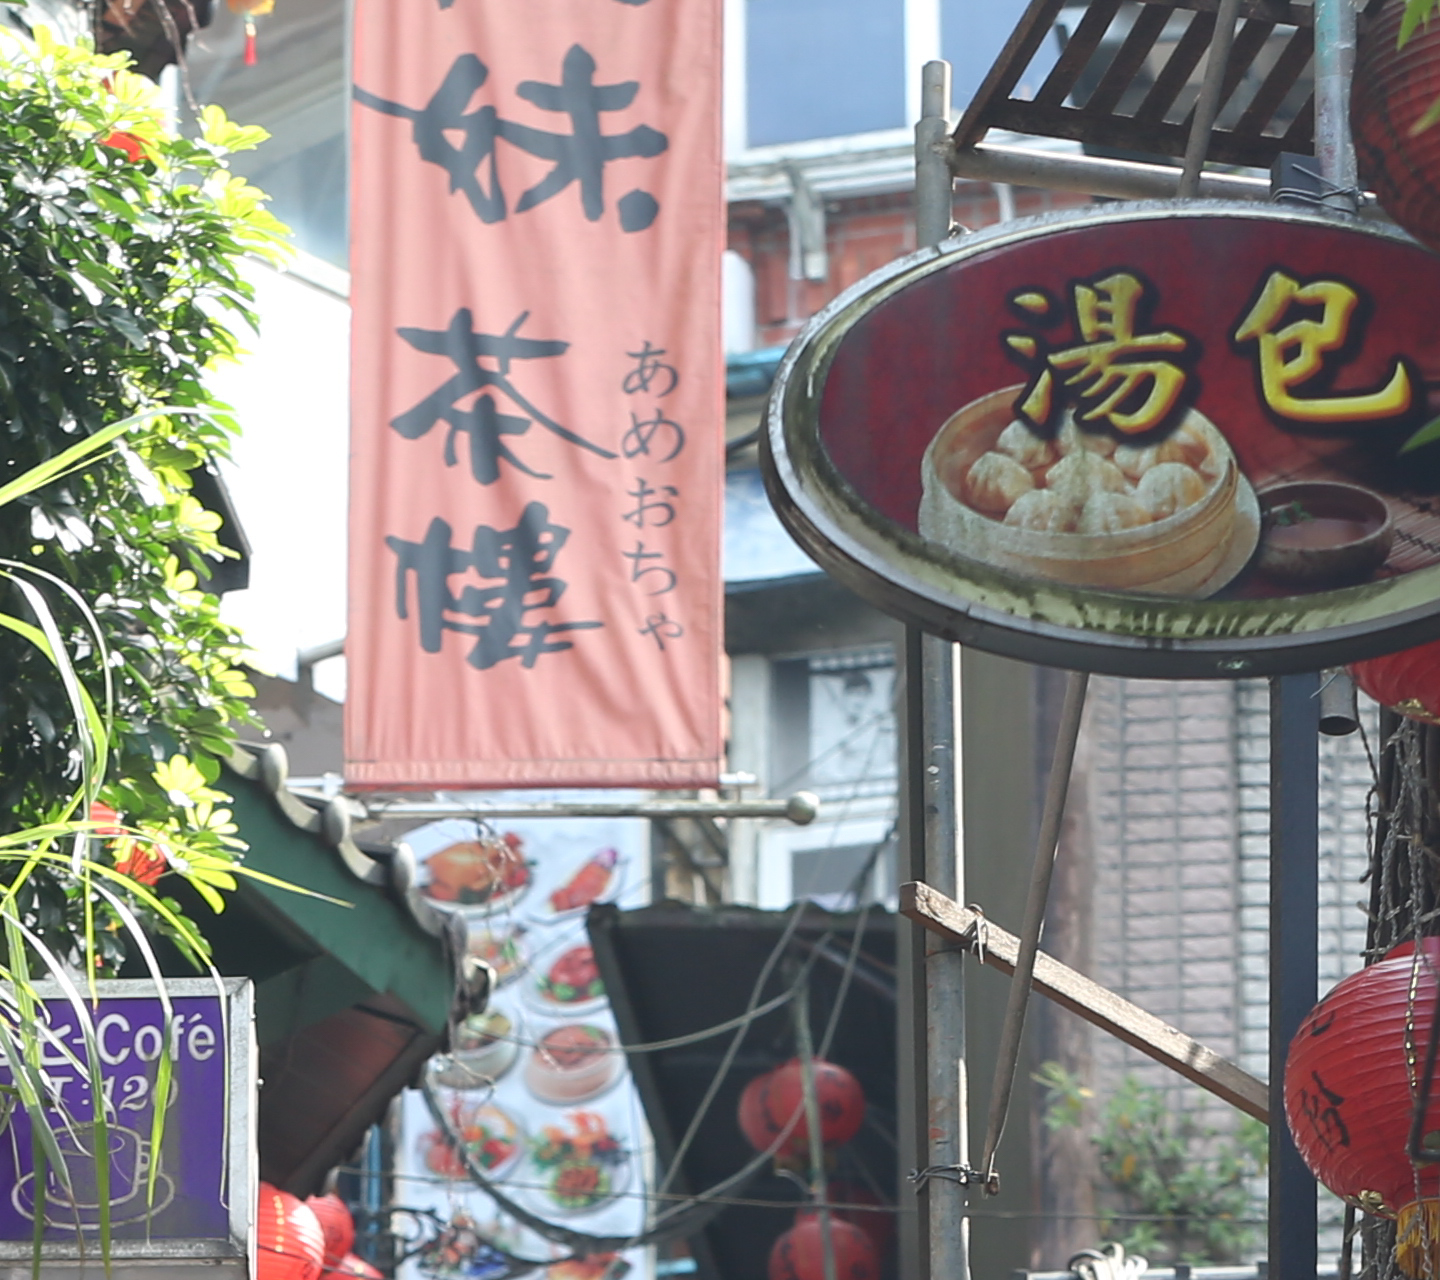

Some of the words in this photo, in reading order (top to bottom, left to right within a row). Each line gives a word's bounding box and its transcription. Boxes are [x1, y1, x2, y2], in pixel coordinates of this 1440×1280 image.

[1006, 271, 1412, 435] 湯包
[621, 340, 685, 651] あめおちゃ
